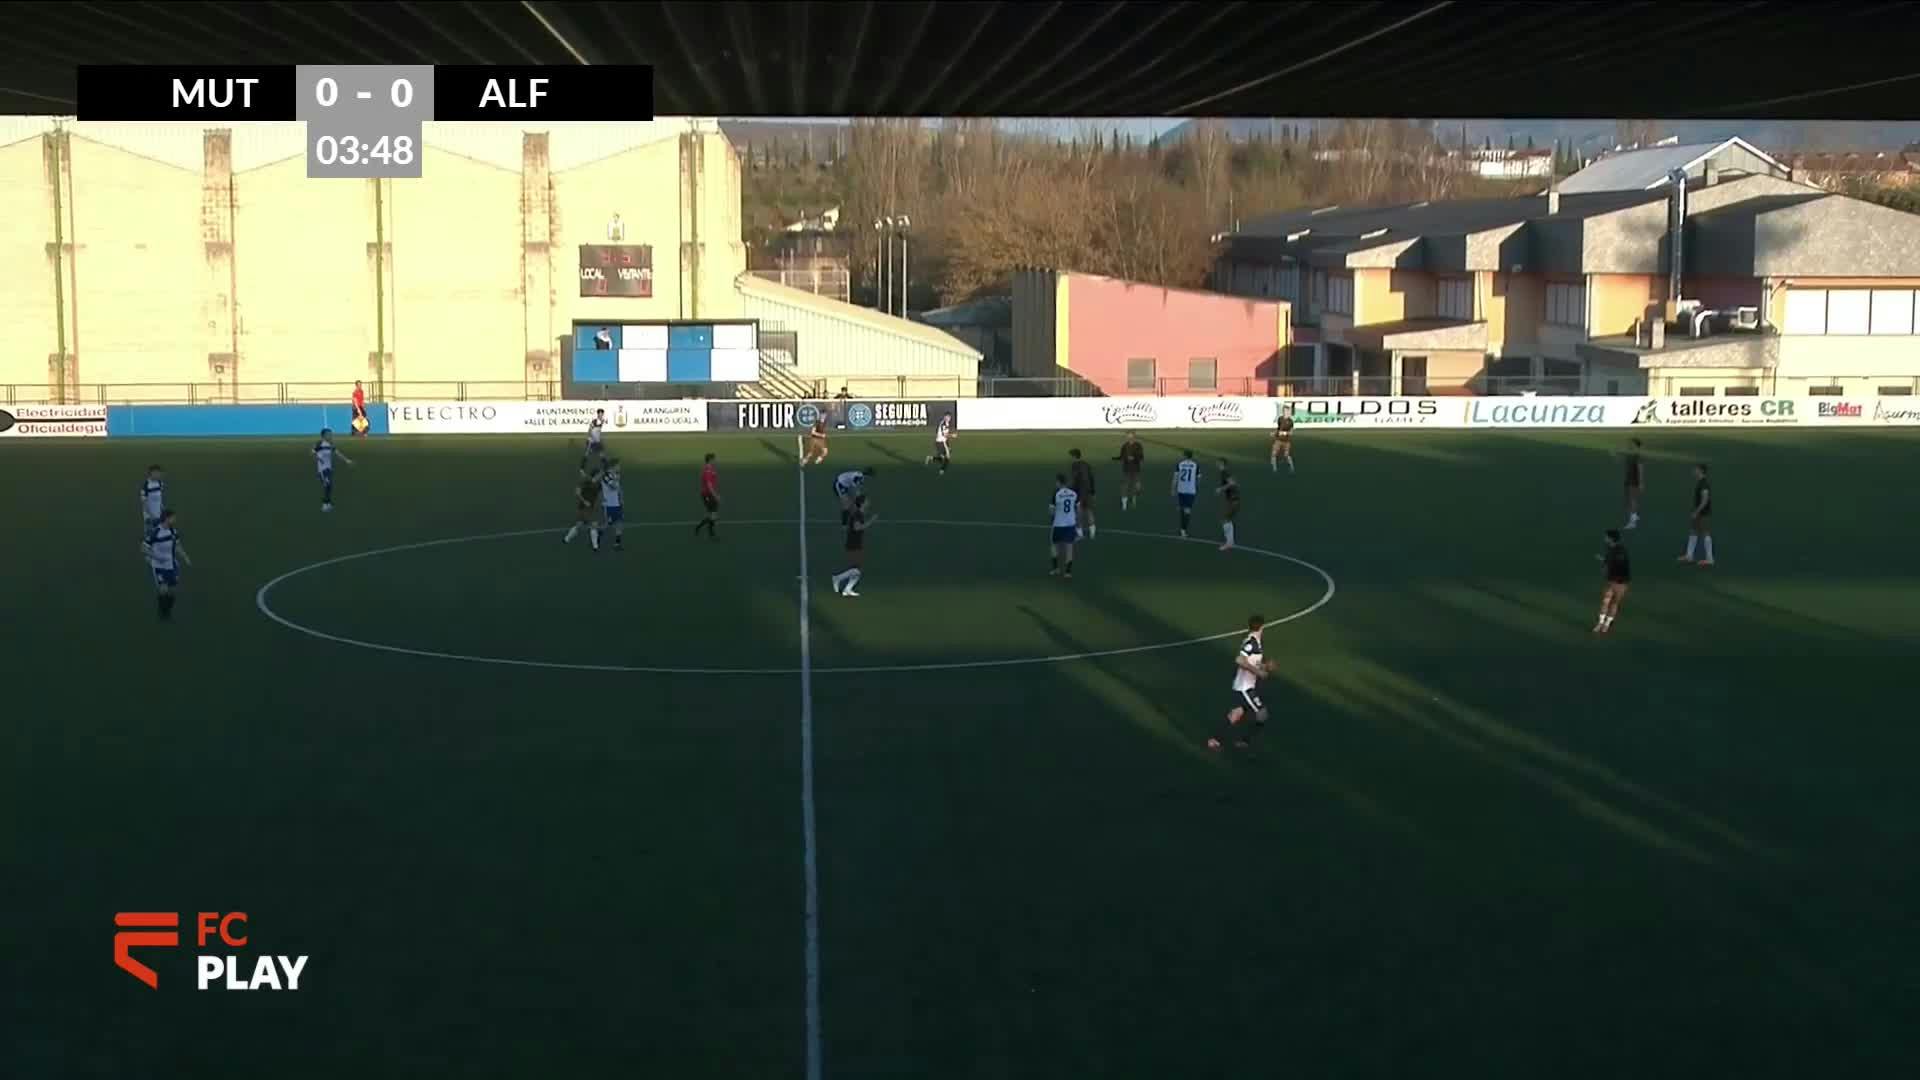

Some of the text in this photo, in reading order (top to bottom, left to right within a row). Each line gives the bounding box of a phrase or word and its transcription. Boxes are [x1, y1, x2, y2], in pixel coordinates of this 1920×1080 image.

[581, 267, 605, 280] LOCAL
[16, 407, 106, 418] Electricidad
[389, 406, 497, 421] YELECTRO
[536, 407, 595, 416] AYUNTAMIENTO
[874, 402, 928, 419] SEGUNDA
[1284, 400, 1437, 416] TOLDOS
[1472, 400, 1606, 424] Lacunza
[1671, 400, 1795, 417] talleres CR
[1818, 402, 1862, 416] BigMat
[523, 417, 546, 426] VALLE
[548, 417, 558, 426] DE
[1180, 468, 1193, 483] 21
[1063, 498, 1072, 514] 8
